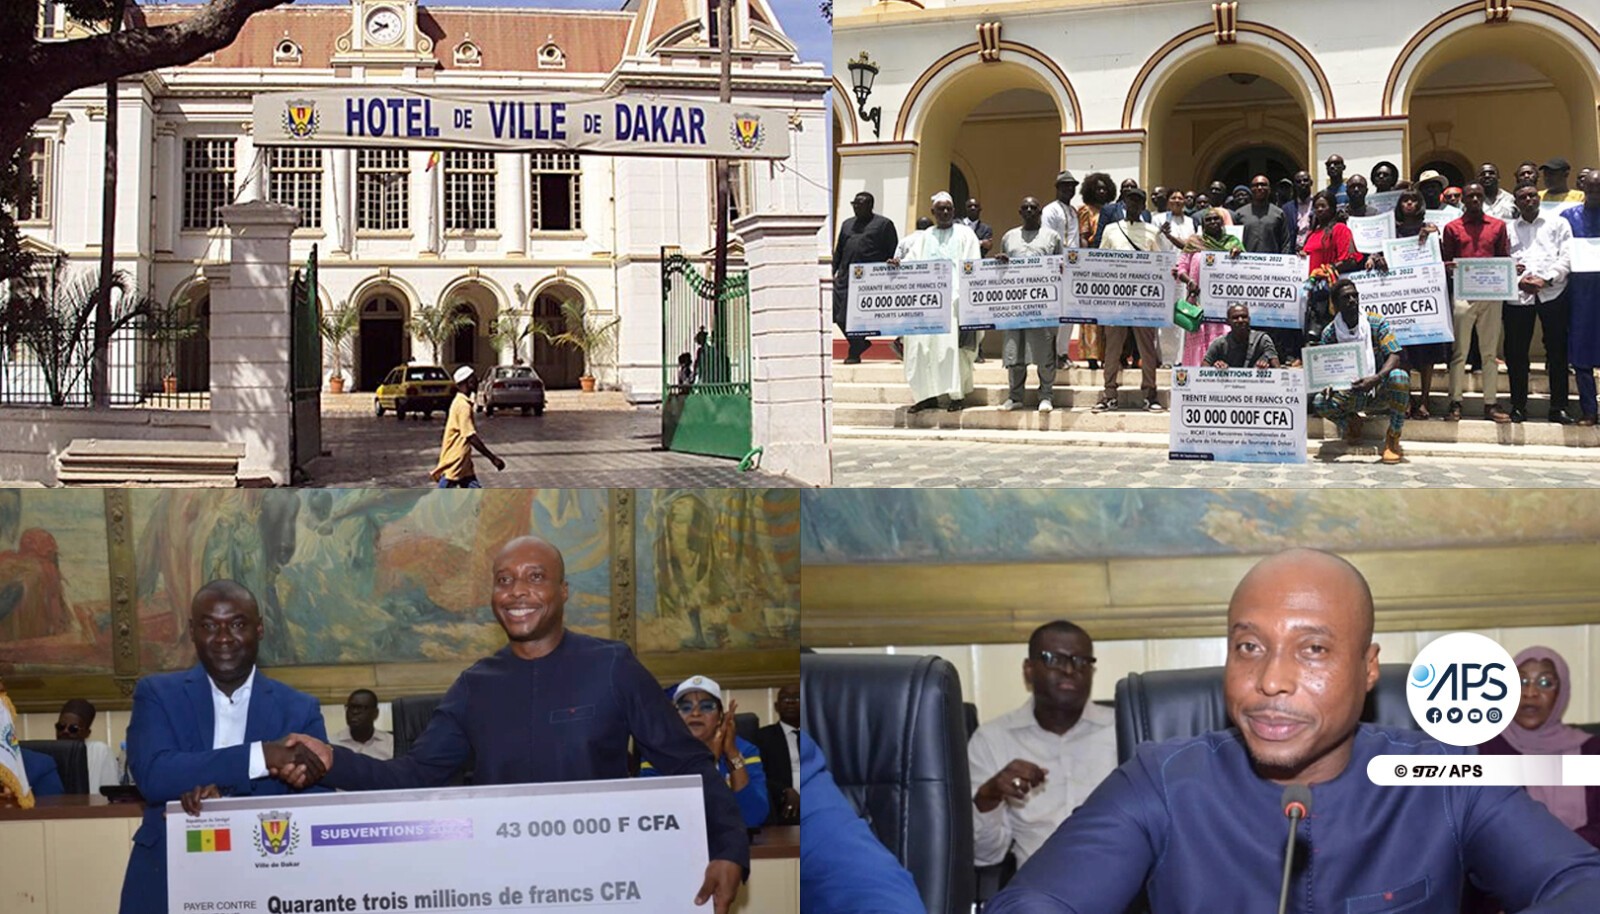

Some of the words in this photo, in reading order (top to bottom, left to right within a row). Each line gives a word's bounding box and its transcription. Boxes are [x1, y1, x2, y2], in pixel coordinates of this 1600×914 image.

[347, 98, 439, 137] HOTEL
[454, 108, 472, 128] DE
[489, 101, 566, 140] VILLE
[583, 114, 601, 134] DE
[615, 103, 706, 144] DAKAR
[1088, 251, 1133, 259] SUBVENTIONS
[972, 291, 984, 302] 20
[986, 290, 1003, 302] 000
[1005, 289, 1028, 300] 000F
[1030, 288, 1048, 299] CFA
[1075, 282, 1088, 294] 20
[1091, 283, 1110, 295] 000
[1113, 284, 1138, 297] 000F
[1140, 285, 1160, 297] CFA
[1212, 284, 1224, 295] 25
[1226, 284, 1244, 296] 000
[1246, 285, 1270, 297] 000F
[1272, 286, 1292, 298] CFA
[1361, 293, 1379, 301] QUINZE
[1380, 290, 1402, 298] MILLIONS
[1411, 287, 1430, 295] FRANCS
[860, 297, 873, 308] 60
[875, 296, 893, 307] 000
[894, 295, 917, 307] 000F
[919, 294, 938, 306] CFA
[1132, 300, 1166, 308] NUMERIQUES
[1381, 301, 1407, 316] 000F
[1410, 299, 1433, 313] CFA
[1199, 369, 1253, 378] SUBVENTIONS
[1255, 370, 1272, 378] 2022
[1182, 394, 1207, 402] TRENTE
[1208, 395, 1242, 403] MILLIONS
[1244, 395, 1253, 403] DE
[1255, 395, 1283, 404] FRANCS
[1285, 396, 1299, 404] CFA
[1186, 408, 1201, 423] 30
[1204, 409, 1227, 424] 000
[1230, 410, 1260, 425] 000F
[1263, 411, 1288, 426] CFA
[320, 824, 424, 840] SUBVENTIONS
[496, 822, 522, 838] 43
[528, 820, 566, 837] 000
[572, 817, 611, 835] 000
[618, 817, 630, 833] F
[638, 814, 680, 832] CFA
[268, 894, 356, 914] Quarante
[363, 891, 408, 911] trois
[414, 889, 492, 909] millions
[498, 887, 523, 906] de
[528, 884, 594, 904] francs
[600, 881, 641, 901] CFA
[183, 901, 215, 911] PAYER
[216, 900, 257, 910] CONTRE
